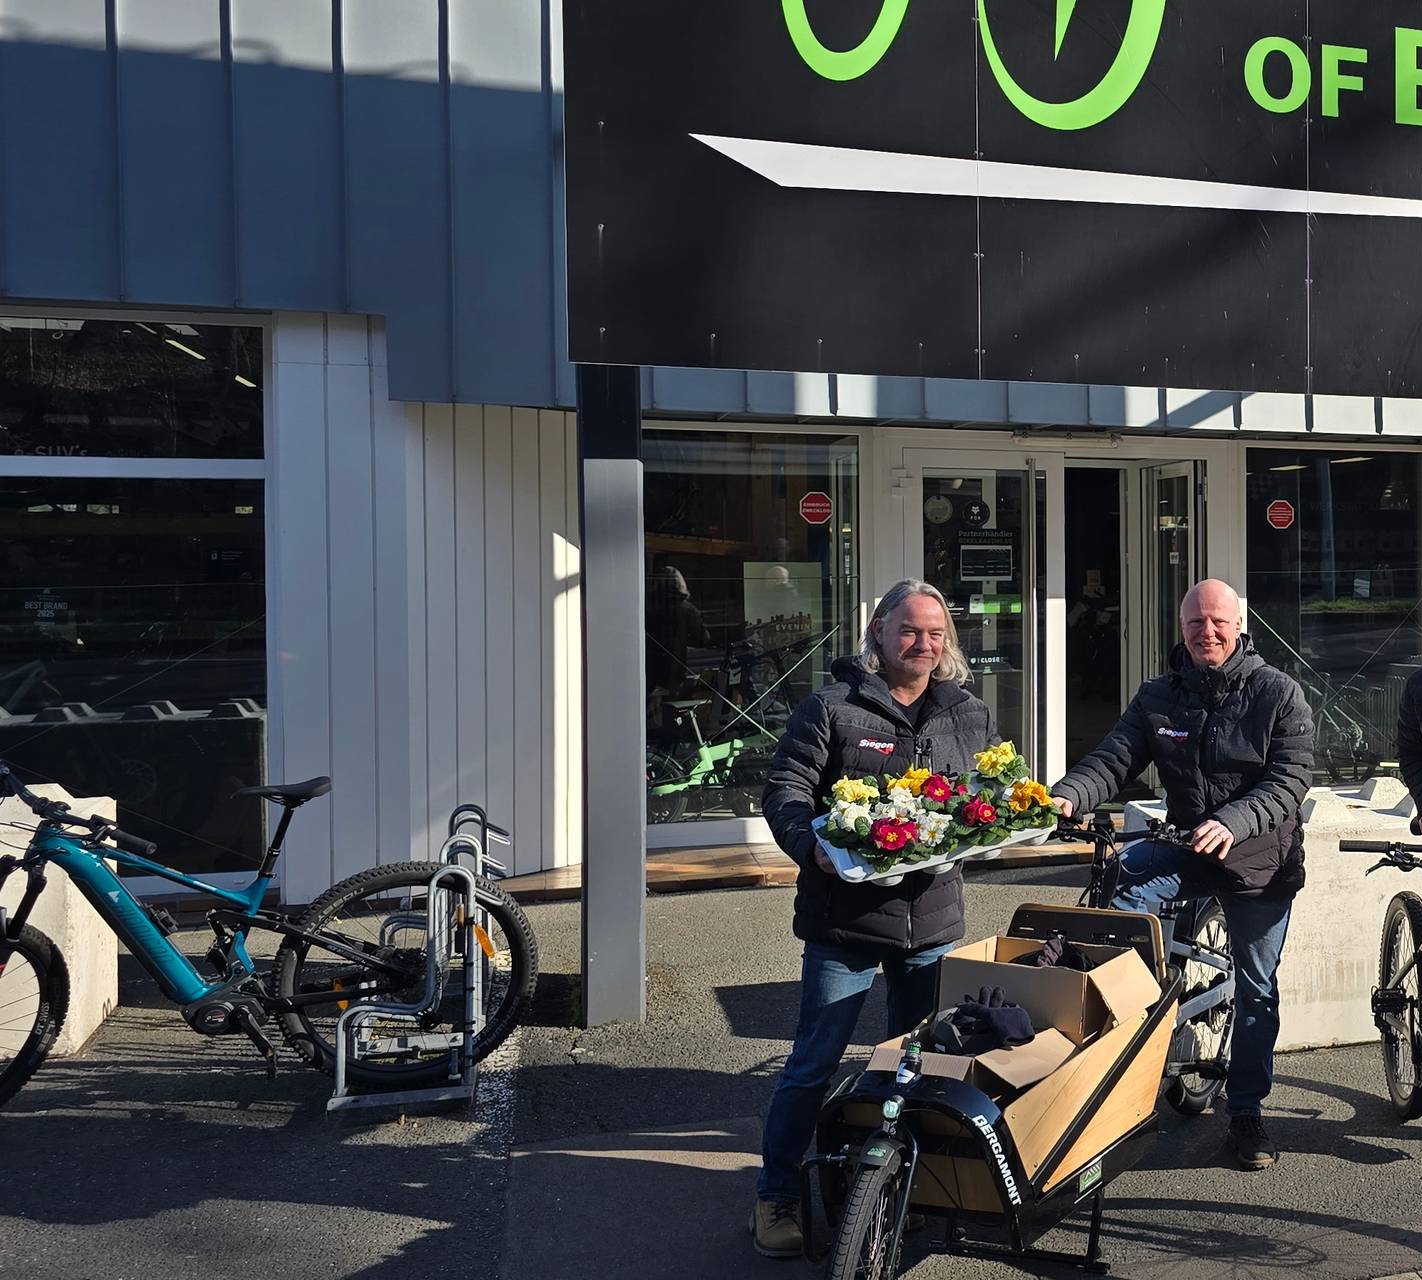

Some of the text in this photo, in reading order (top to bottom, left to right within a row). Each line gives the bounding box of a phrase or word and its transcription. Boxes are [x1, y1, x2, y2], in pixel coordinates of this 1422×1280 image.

[1244, 36, 1368, 118] OF
[24, 601, 68, 610] BEST BRAND
[36, 609, 55, 618] 2025
[972, 1114, 1022, 1206] BERGAMONT
